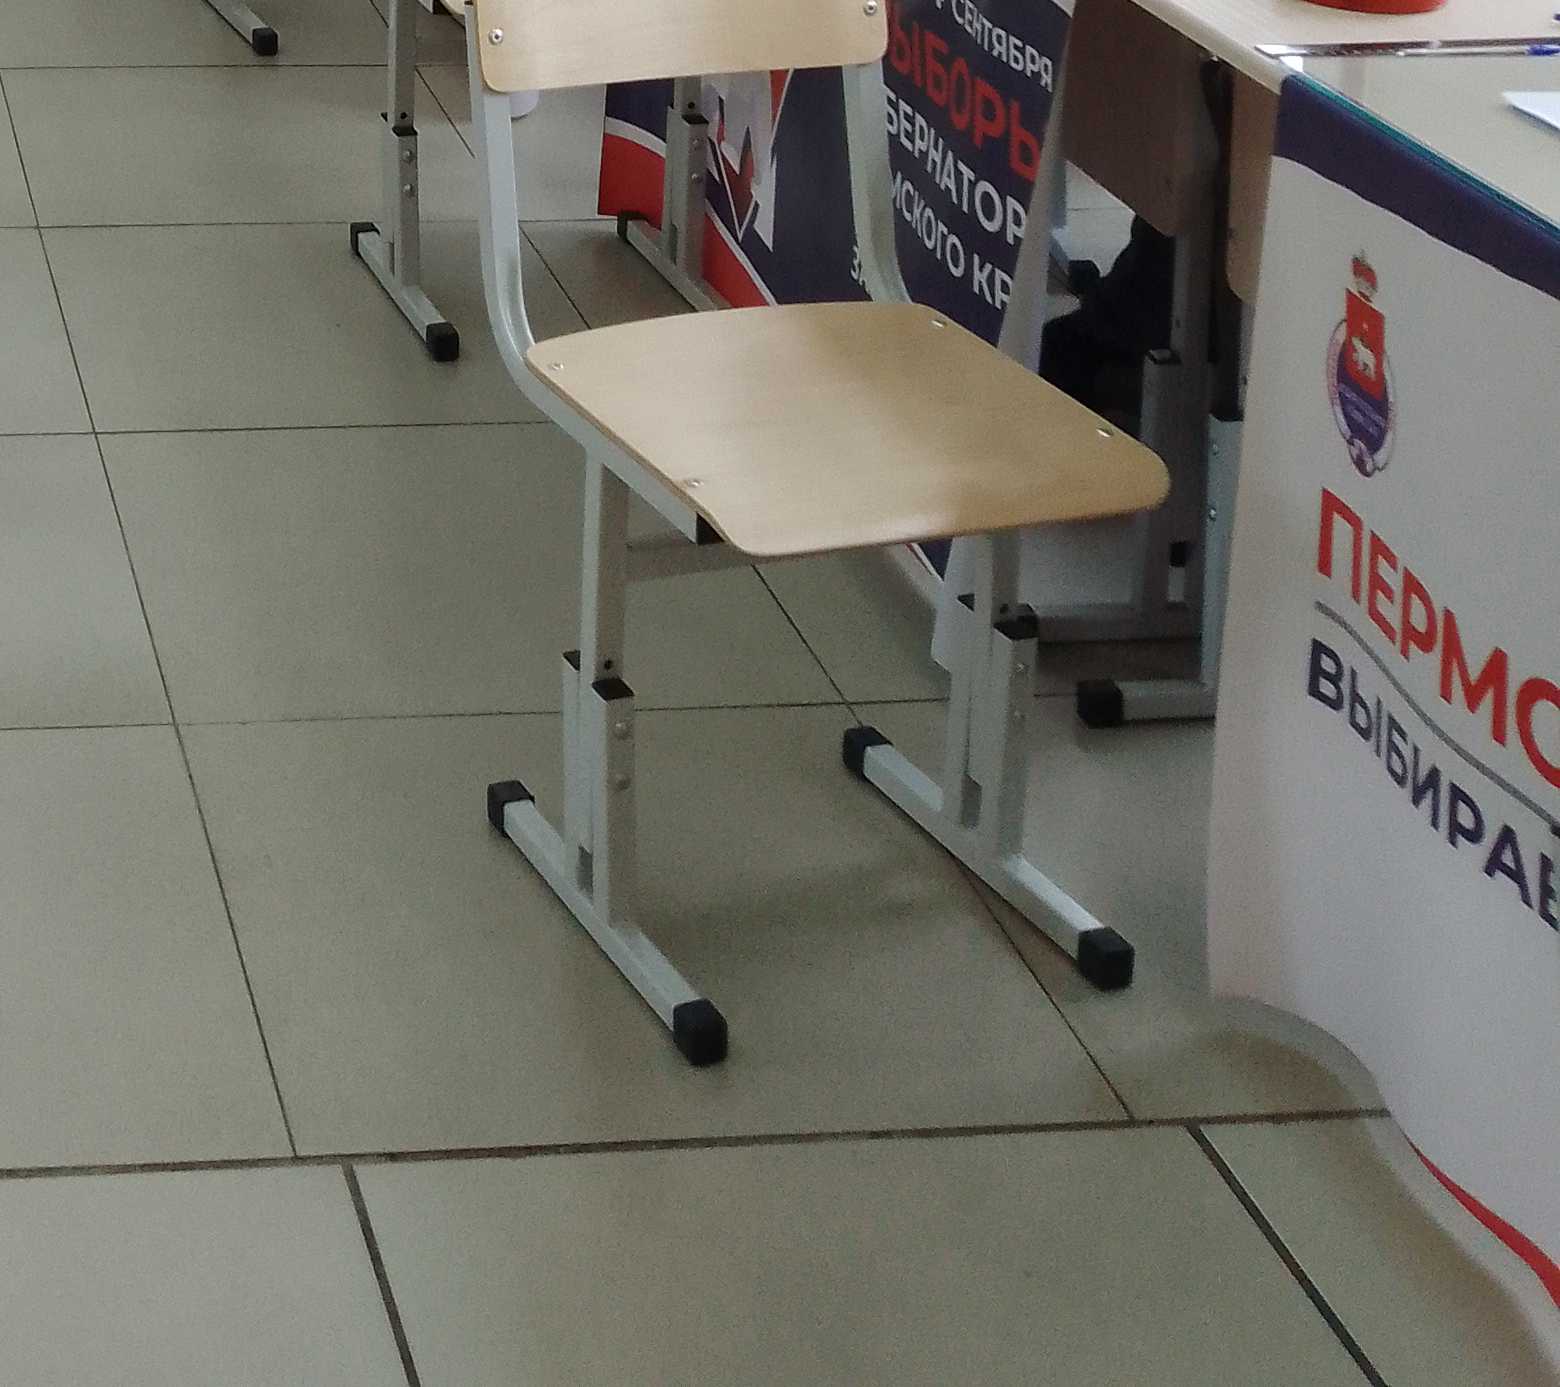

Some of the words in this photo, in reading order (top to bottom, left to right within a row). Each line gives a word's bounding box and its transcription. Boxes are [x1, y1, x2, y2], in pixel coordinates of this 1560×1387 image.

[885, 87, 1028, 246] БЕРНАТОР
[972, 253, 1013, 310] КР
[1307, 637, 1560, 930] ВЫБИРАЕ
